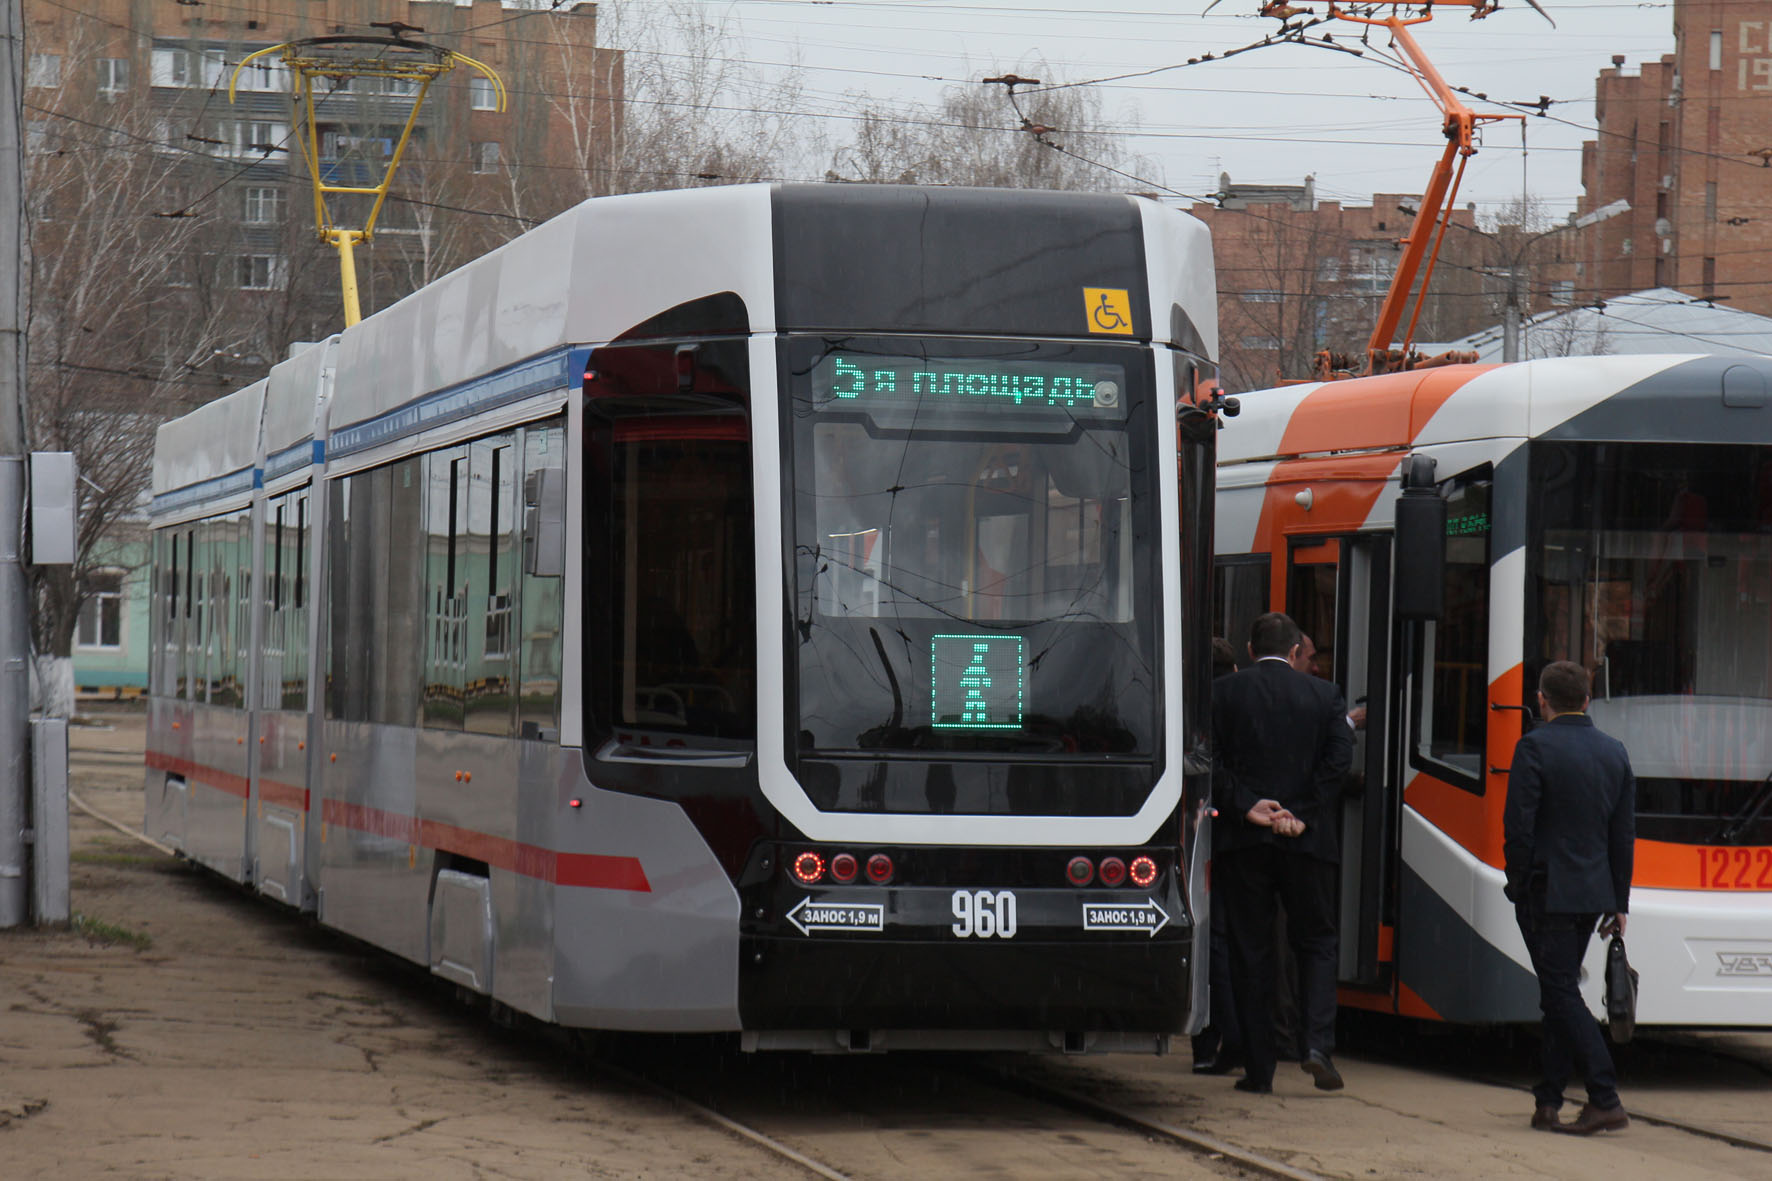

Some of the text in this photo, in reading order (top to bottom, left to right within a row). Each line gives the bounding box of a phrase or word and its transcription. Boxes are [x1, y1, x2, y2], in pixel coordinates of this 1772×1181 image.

[913, 371, 1096, 407] площадь
[1696, 847, 1772, 889] 1222
[804, 910, 846, 924] ЗАНОС
[848, 910, 866, 926] 1,9
[951, 890, 1017, 939] 960
[1089, 910, 1128, 924] ЗАНОС
[1129, 910, 1145, 926] 1,9
